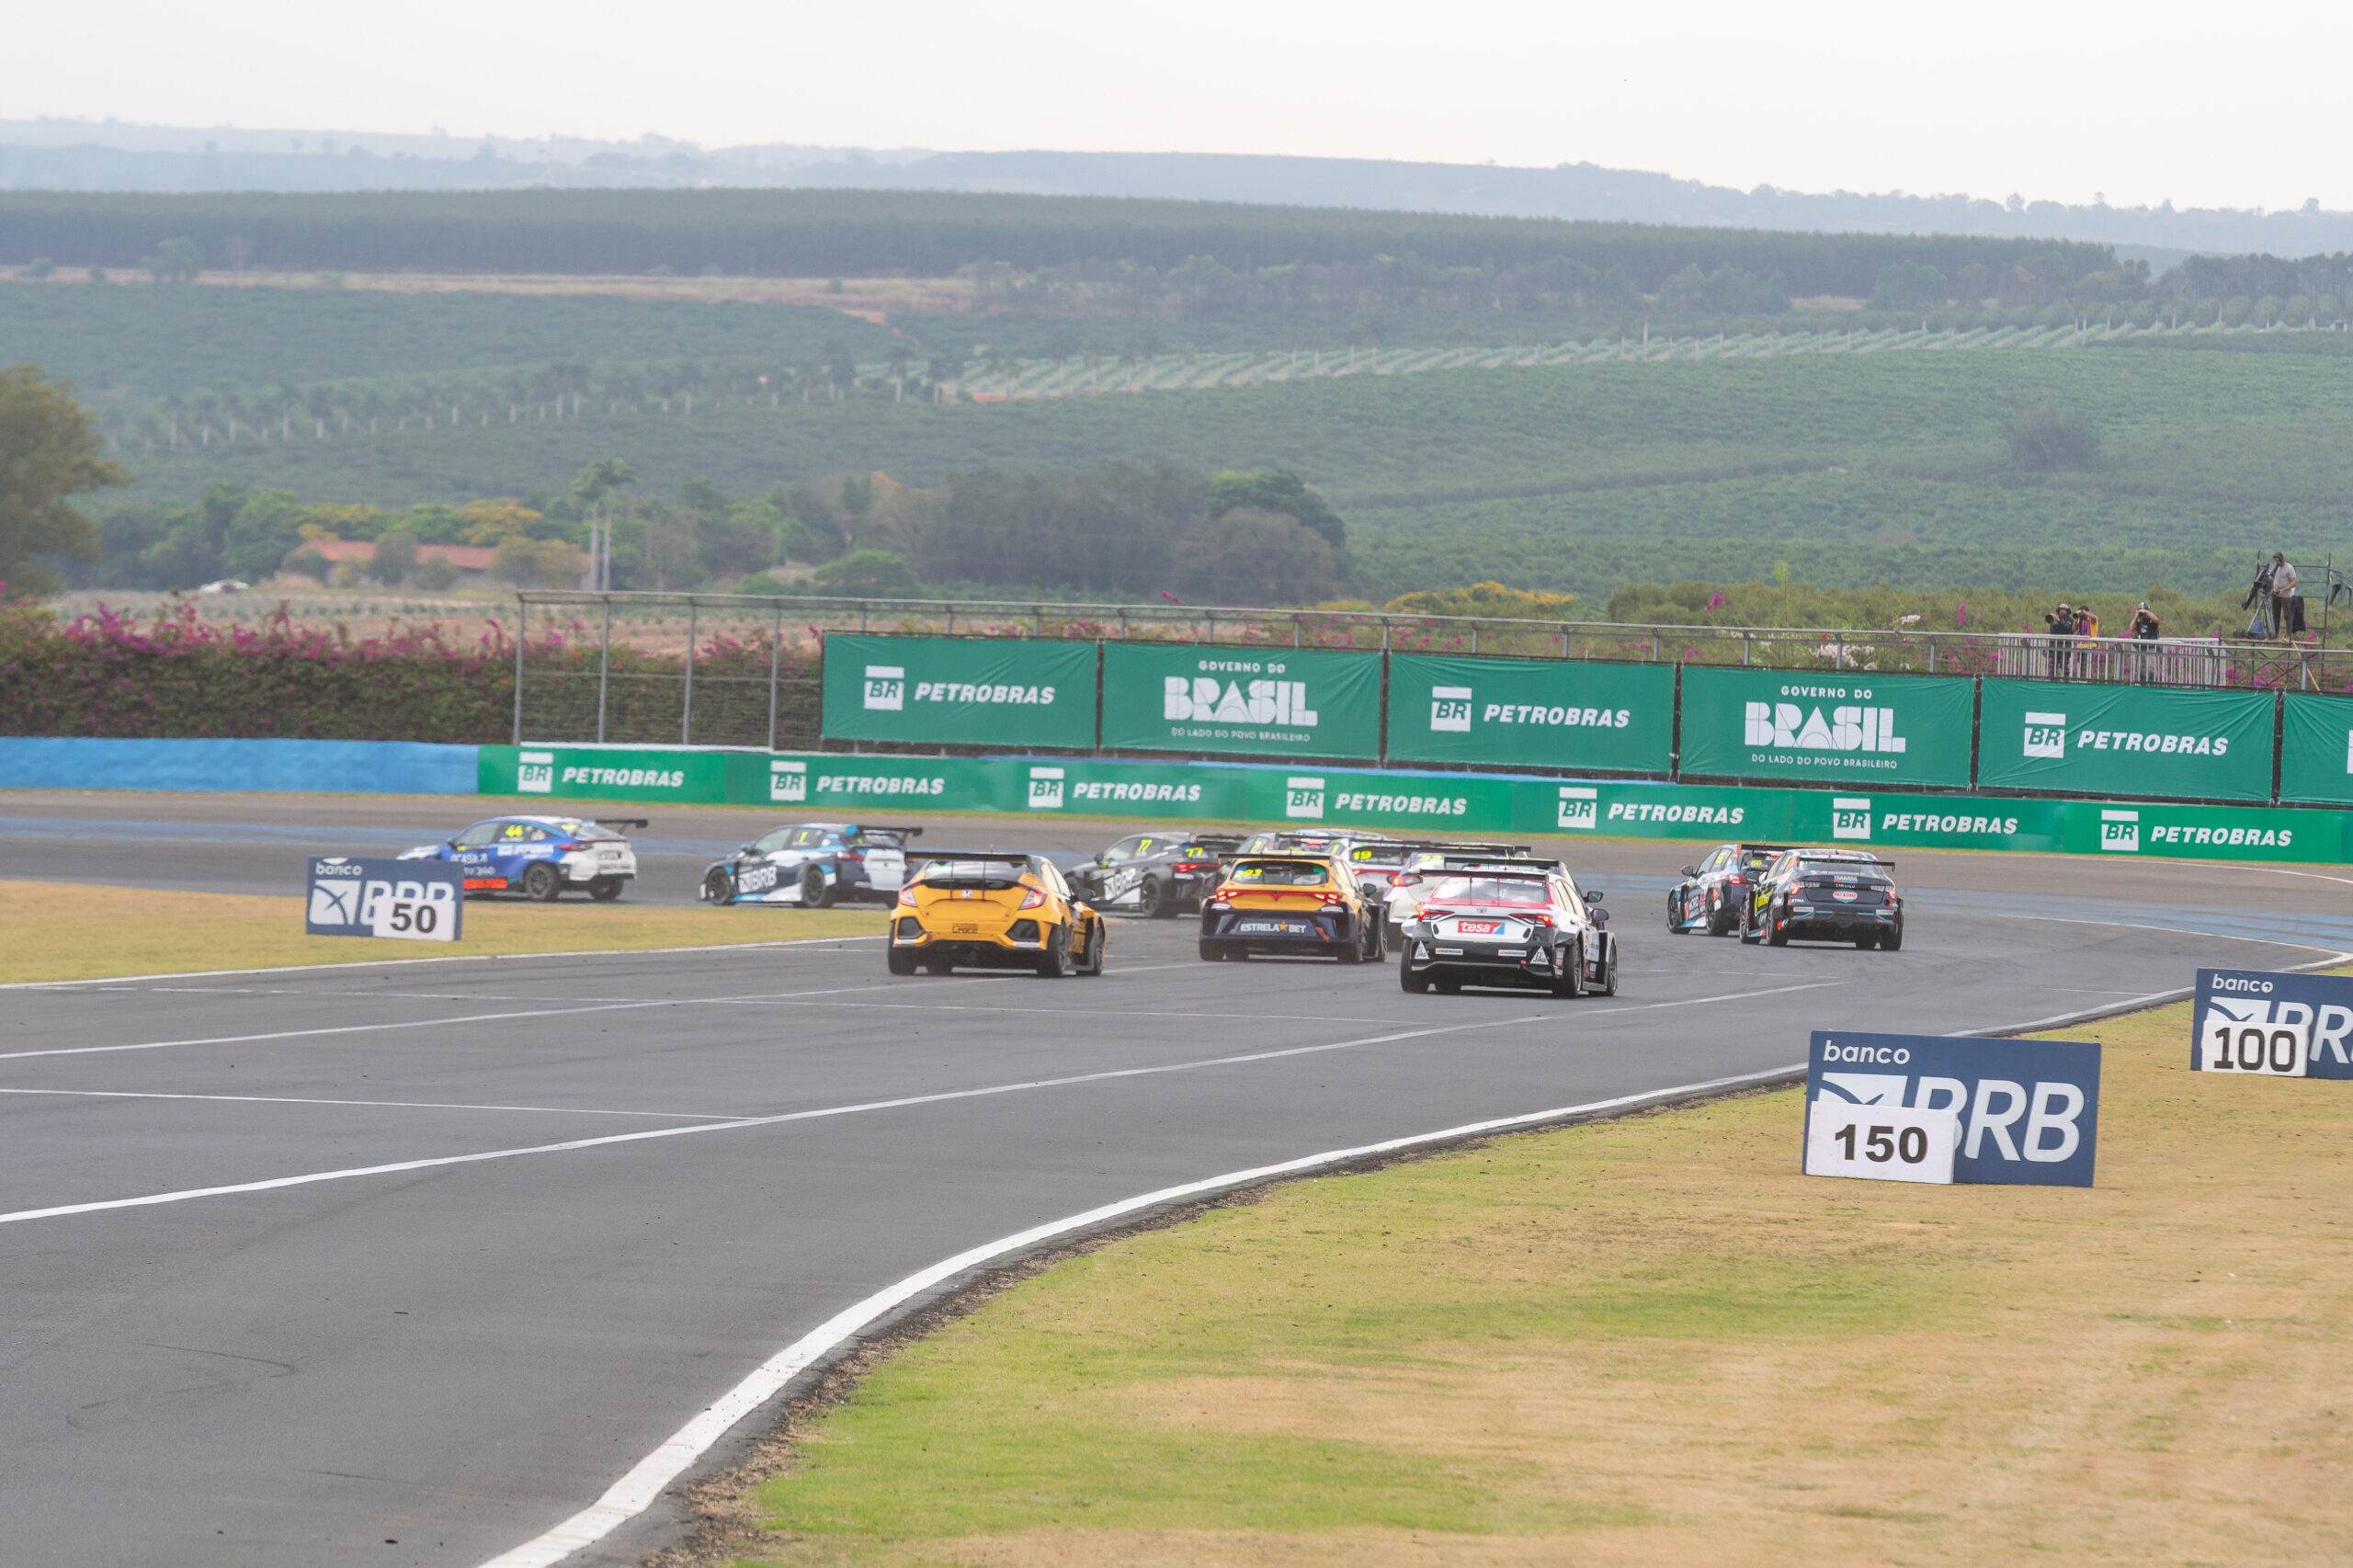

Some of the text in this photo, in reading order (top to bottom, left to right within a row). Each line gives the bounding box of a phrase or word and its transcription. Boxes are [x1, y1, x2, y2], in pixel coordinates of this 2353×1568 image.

[1199, 661, 1286, 674] GOVERNO DO
[915, 682, 1054, 705] PETROBRAS
[1164, 676, 1318, 727] BRASIL
[1780, 686, 1873, 699] GOVERNO DO
[1483, 704, 1631, 729] PETROBRAS
[1745, 701, 1906, 753] BRASIL
[1171, 727, 1311, 743] DO LADO DO POVO BRASILEIRO
[2077, 730, 2229, 756] PETROBRAS
[1751, 754, 1898, 769] DO LADO DO POVO BRASILEIRO
[562, 767, 684, 788] PETROBRAS
[816, 775, 945, 795] PETROBRAS
[1073, 782, 1201, 802] PETROBRAS
[1335, 792, 1468, 815] PETROBRAS
[1607, 802, 1745, 824] PETROBRAS
[1881, 813, 2018, 835] PETROBRAS
[2150, 825, 2292, 847] PETROBRAS
[1352, 850, 1372, 860] 19
[316, 862, 363, 876] banco
[390, 902, 437, 934] 50
[1241, 922, 1306, 933] ESTRELA BET
[1460, 921, 1492, 934] tesa
[2211, 973, 2274, 994] banco
[1823, 1040, 1911, 1065] banco
[2214, 1027, 2296, 1073] 100
[1835, 1123, 1928, 1165] 150
